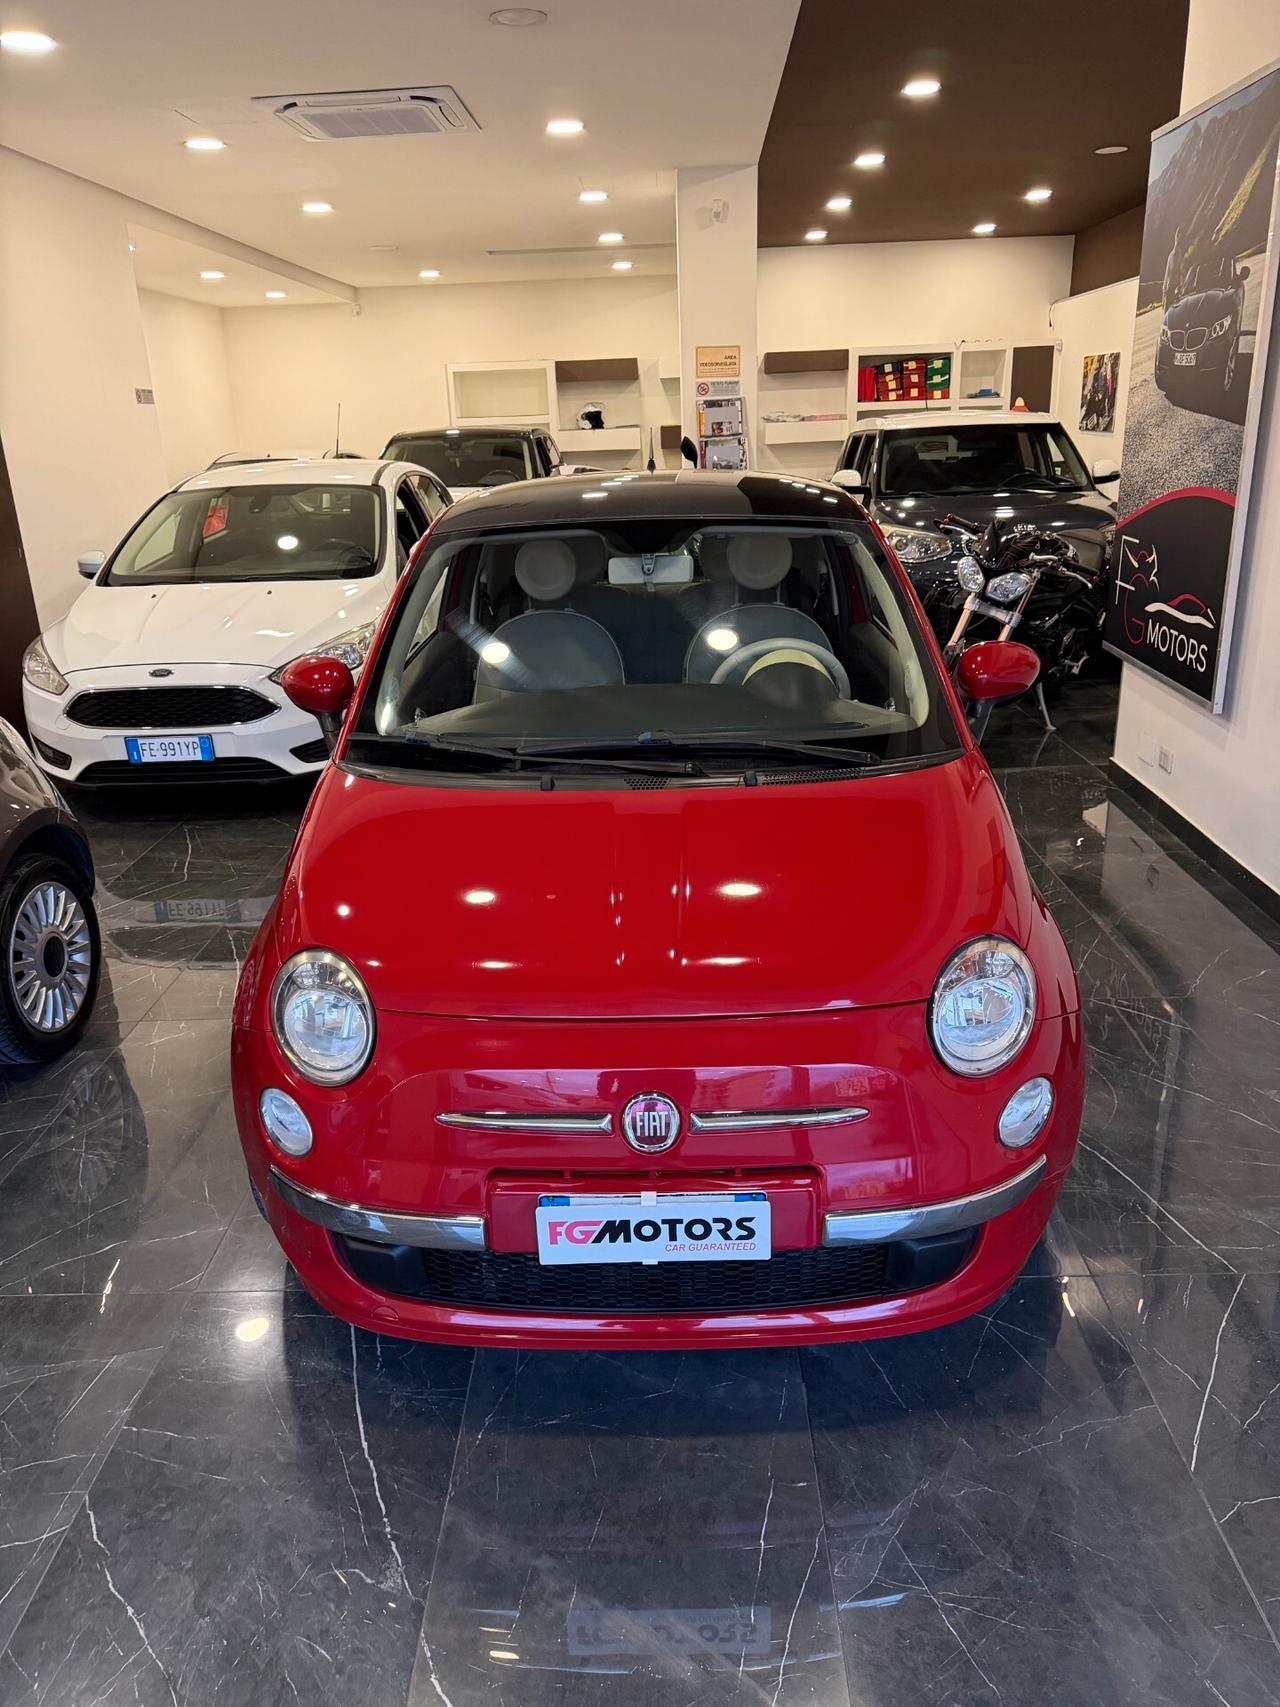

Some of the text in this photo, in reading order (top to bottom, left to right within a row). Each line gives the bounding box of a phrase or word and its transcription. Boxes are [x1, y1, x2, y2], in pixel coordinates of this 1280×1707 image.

[1146, 619, 1208, 672] MOTORS
[636, 1111, 669, 1137] FIAT
[665, 1242, 756, 1252] CAR GUARANTEED
